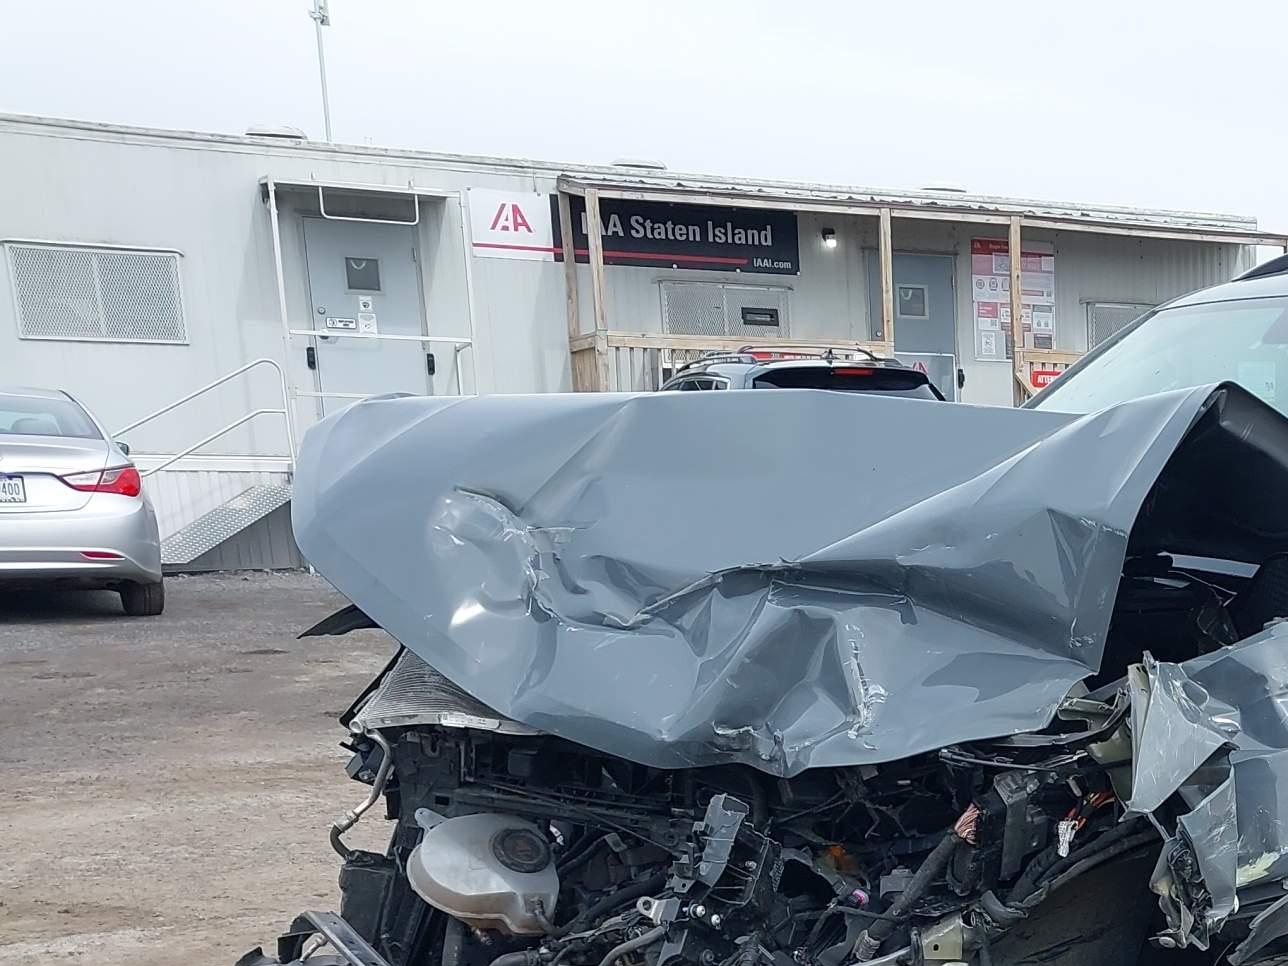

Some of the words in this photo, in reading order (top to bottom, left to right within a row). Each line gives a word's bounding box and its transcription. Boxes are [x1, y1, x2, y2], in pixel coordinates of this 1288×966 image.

[630, 215, 701, 242] Staten
[707, 220, 773, 247] Island
[753, 257, 792, 269] IAAI.com
